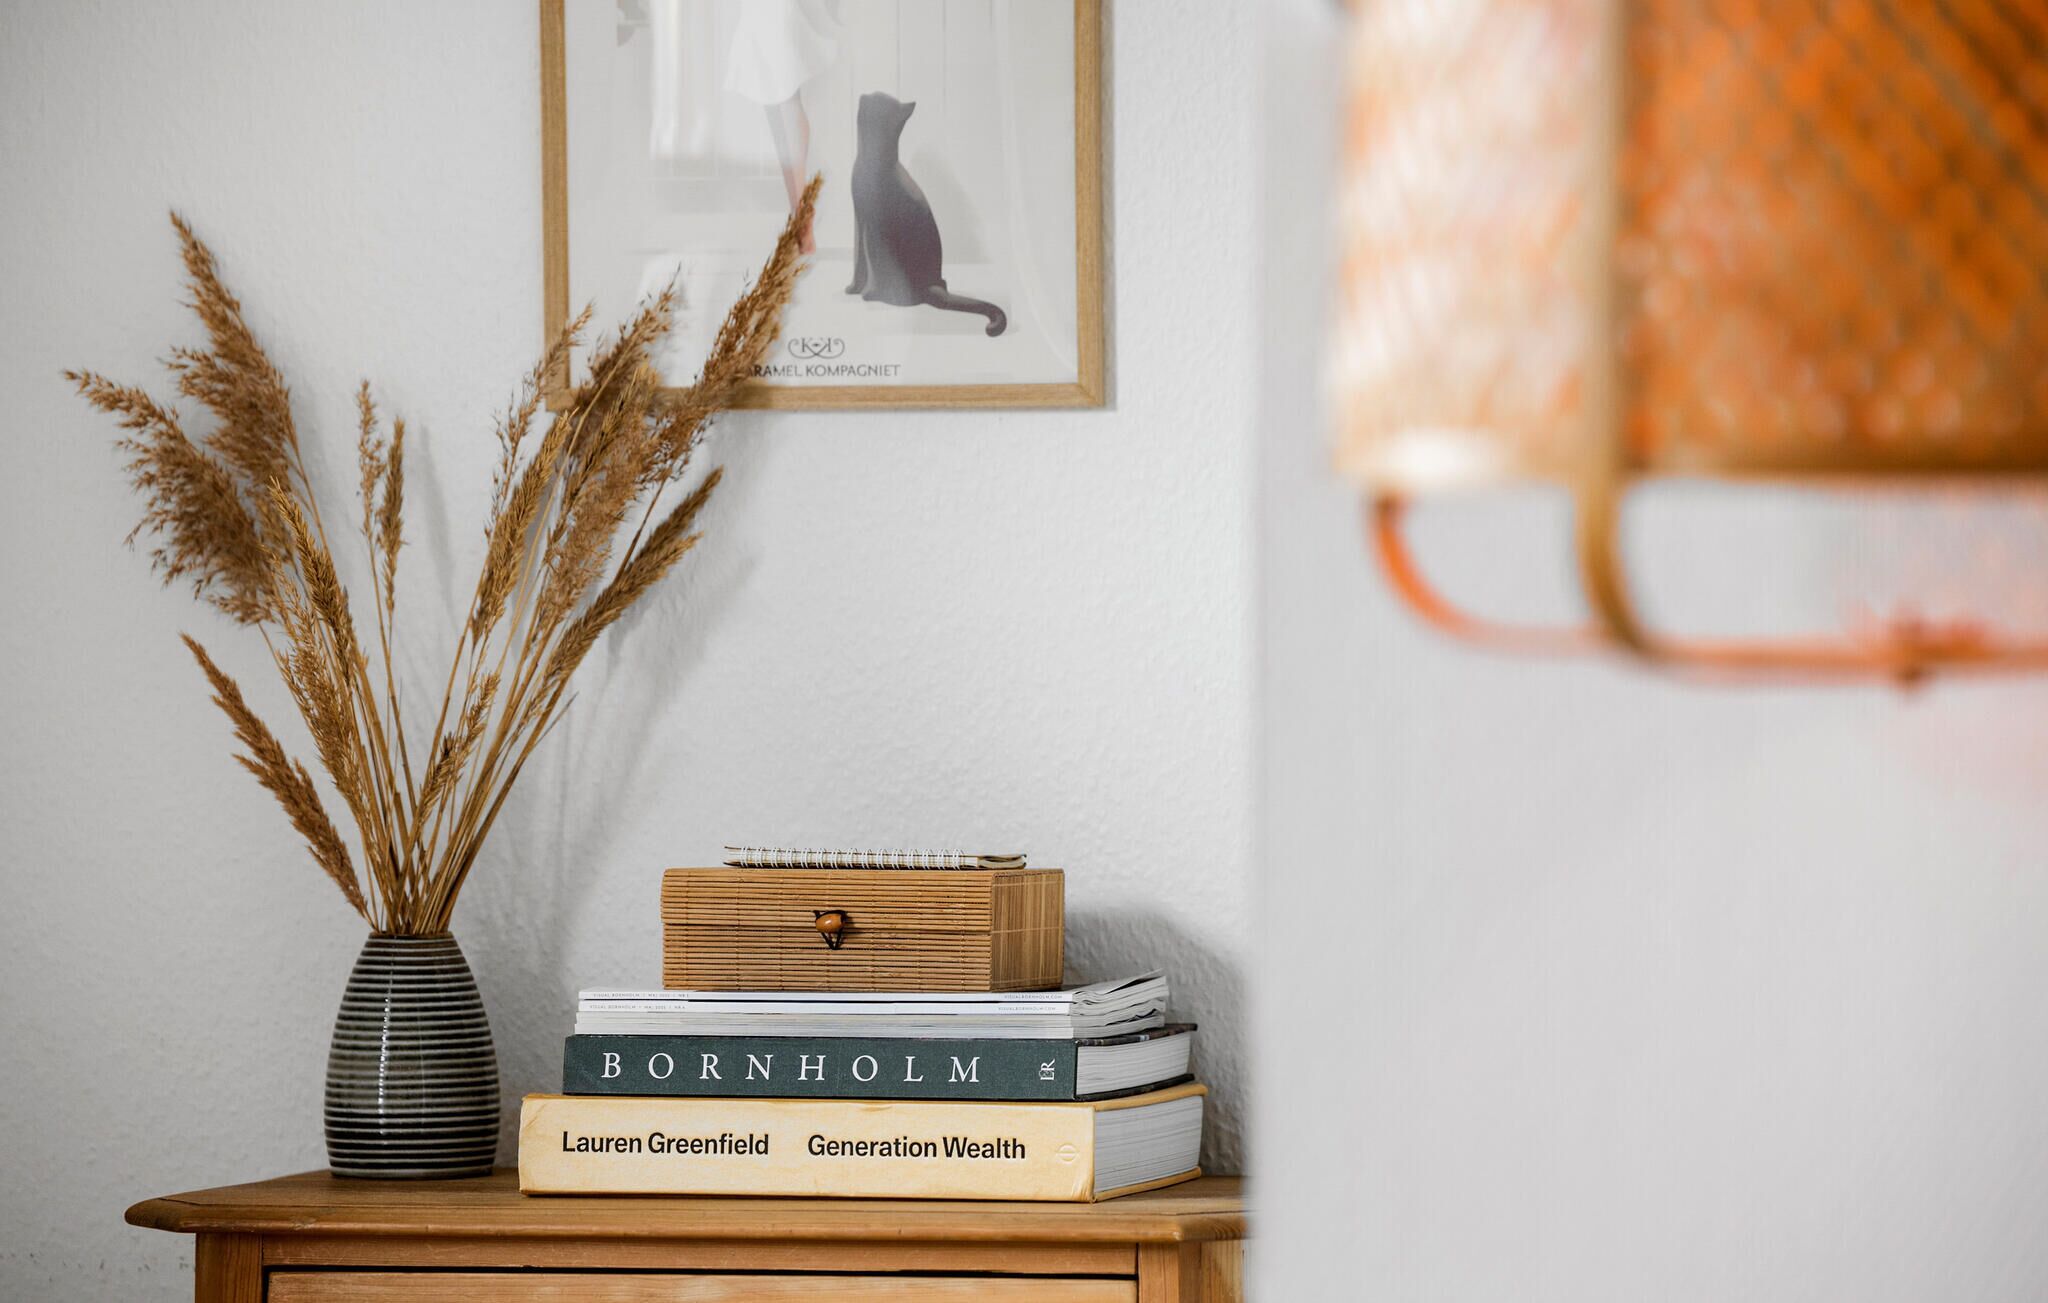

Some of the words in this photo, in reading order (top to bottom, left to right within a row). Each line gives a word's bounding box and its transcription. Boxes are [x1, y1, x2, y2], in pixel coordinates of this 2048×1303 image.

[748, 364, 802, 377] ARAMEL
[805, 364, 901, 377] KOMPAGNIET
[601, 1052, 981, 1083] BORNHOLM
[563, 1131, 642, 1153] Lauren
[648, 1132, 769, 1155] Greenfield
[808, 1134, 938, 1158] Generation
[943, 1136, 1026, 1160] Wealth
